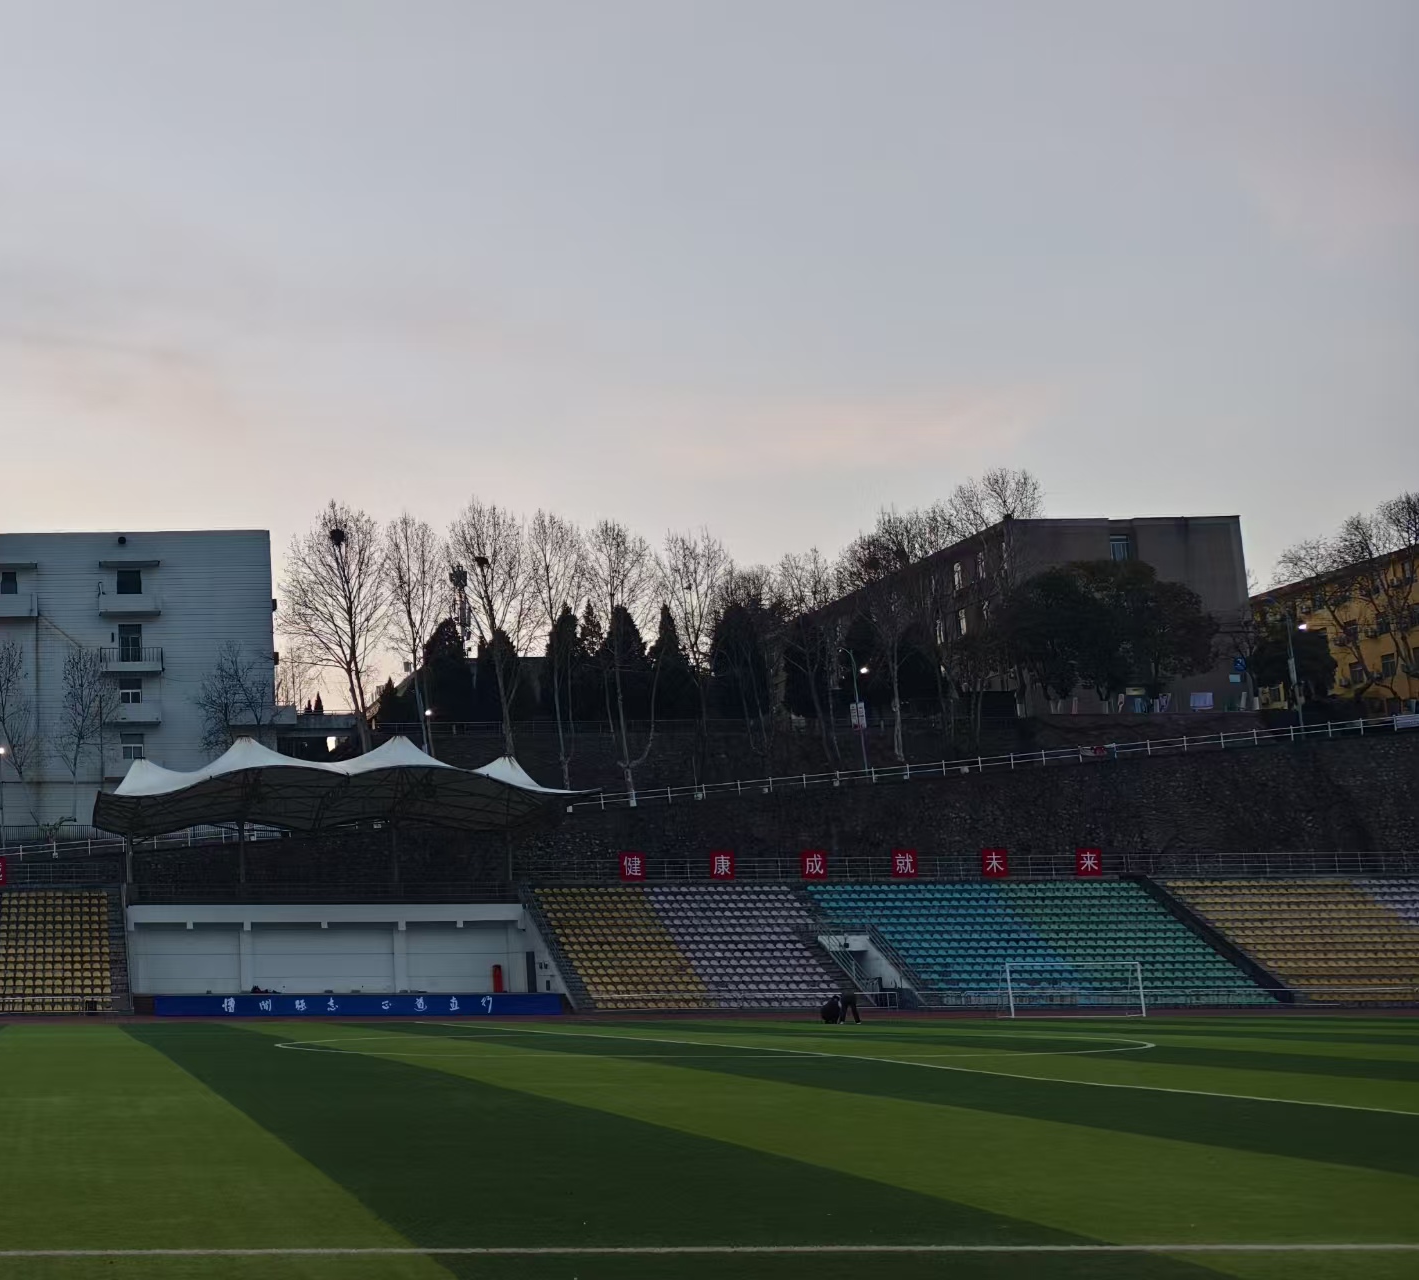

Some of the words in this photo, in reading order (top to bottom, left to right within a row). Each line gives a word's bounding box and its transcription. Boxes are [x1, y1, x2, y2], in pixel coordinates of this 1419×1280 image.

[623, 853, 1098, 876] 健康成就未来
